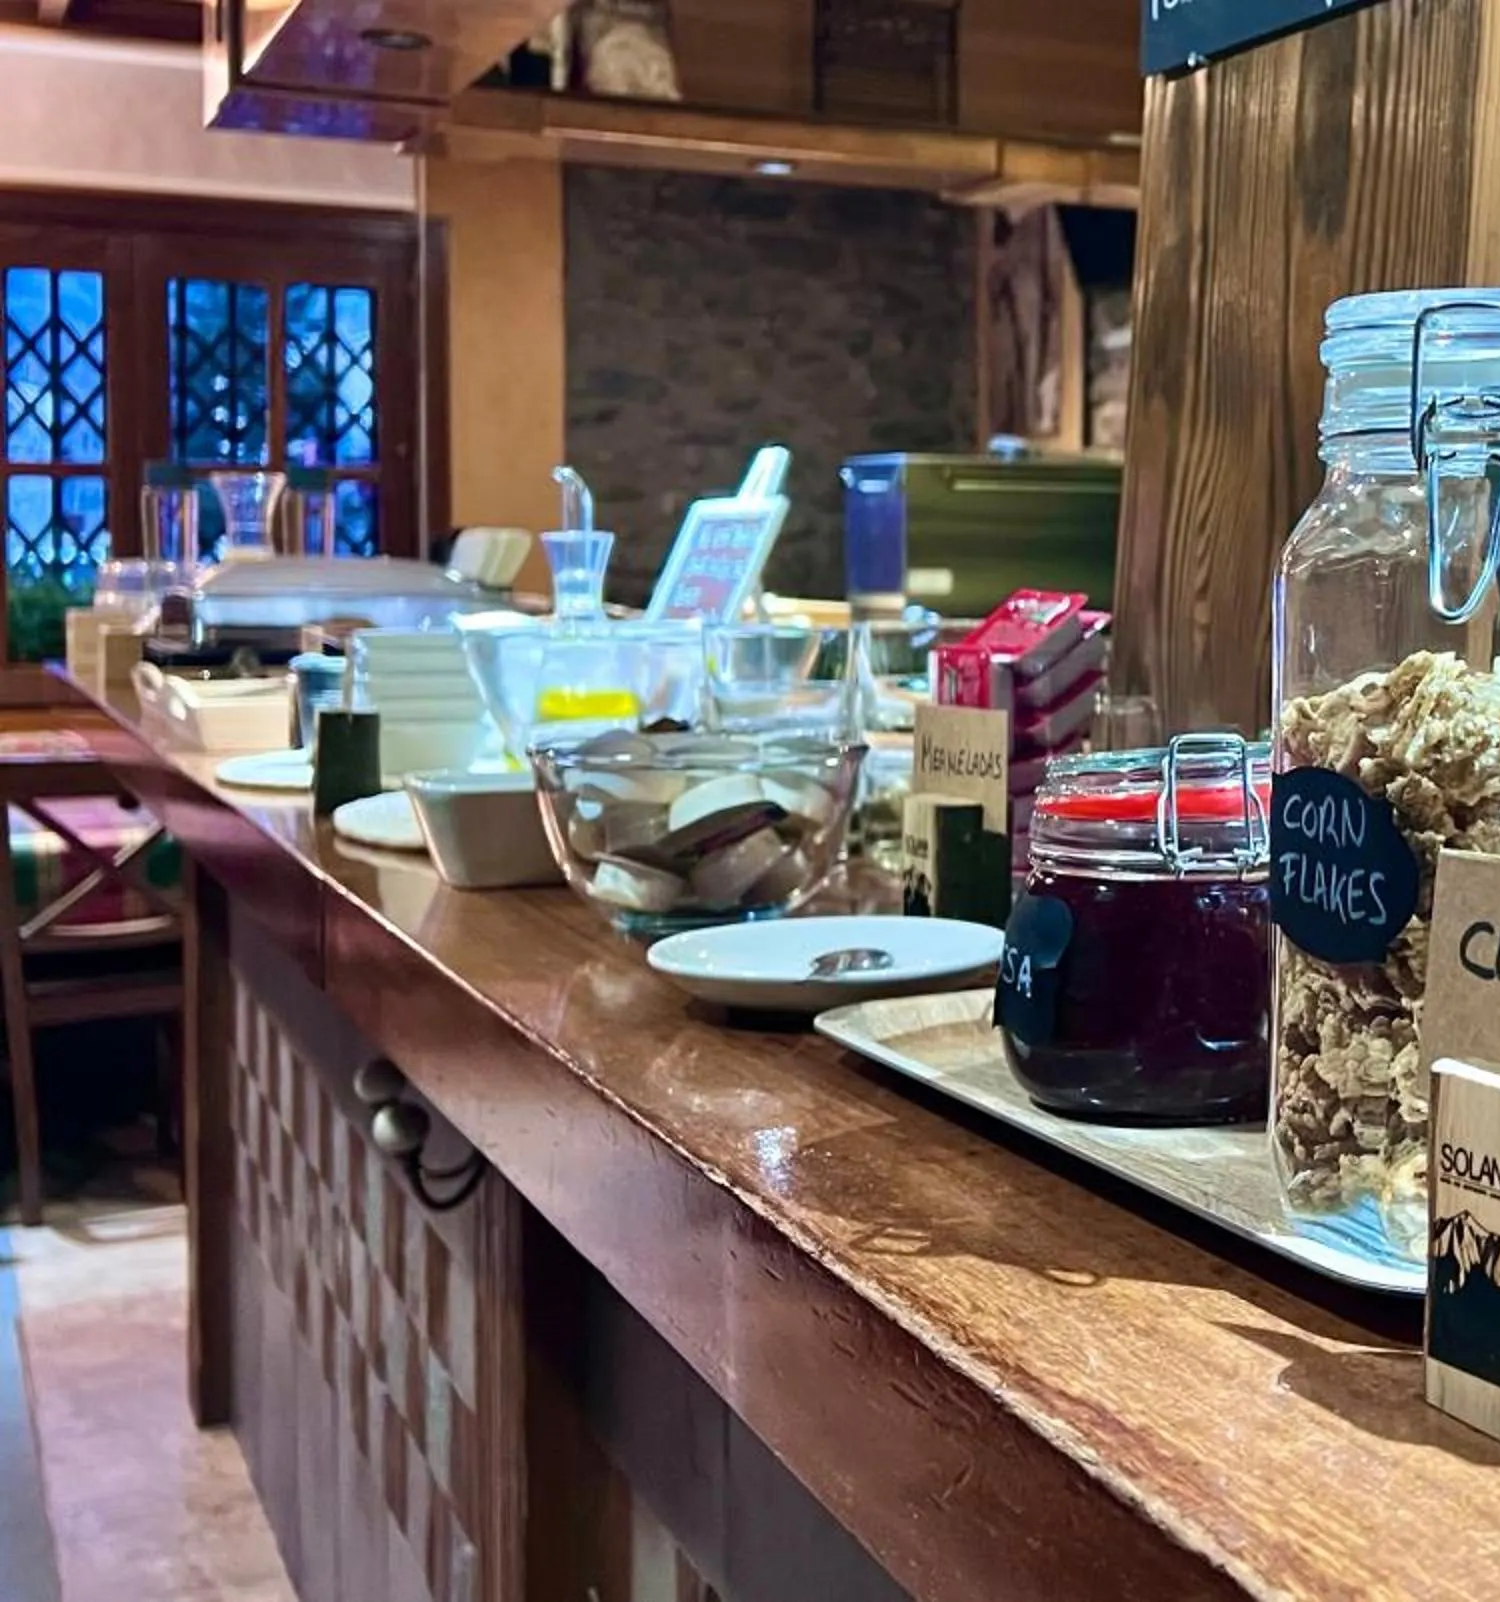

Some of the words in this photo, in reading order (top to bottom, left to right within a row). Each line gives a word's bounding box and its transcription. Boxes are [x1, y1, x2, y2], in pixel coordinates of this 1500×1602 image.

[1283, 793, 1366, 848] CORN
[1279, 852, 1387, 925] FLAKES
[1002, 944, 1032, 998] SA
